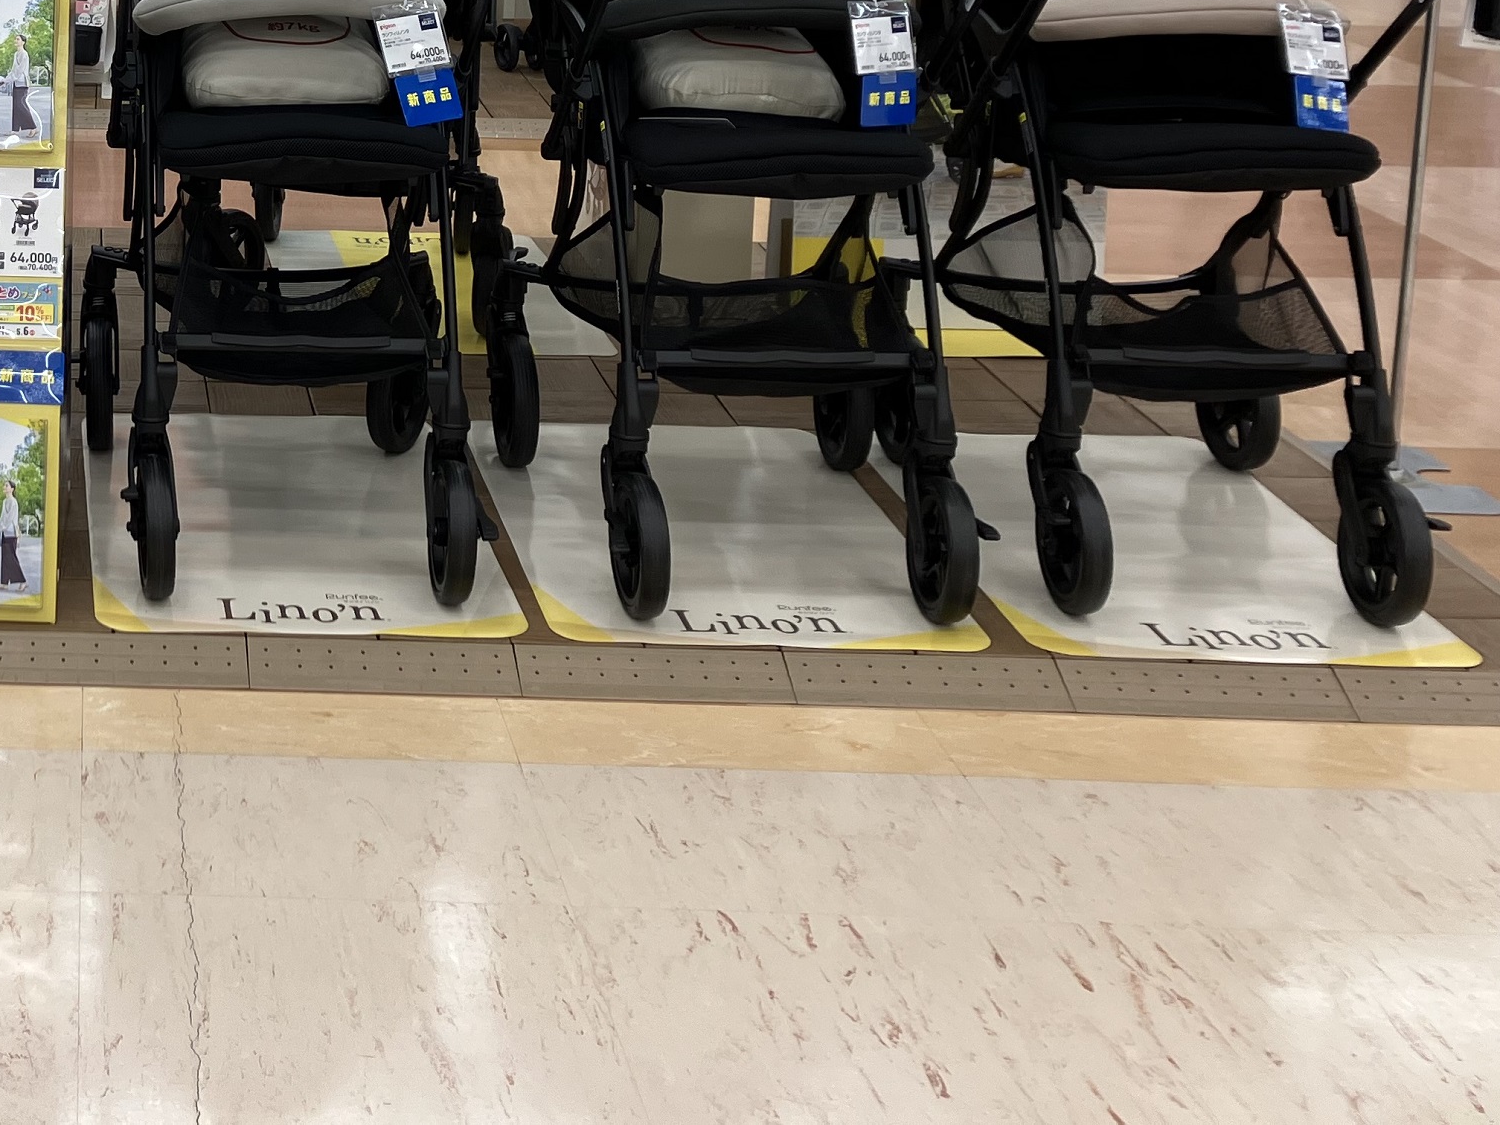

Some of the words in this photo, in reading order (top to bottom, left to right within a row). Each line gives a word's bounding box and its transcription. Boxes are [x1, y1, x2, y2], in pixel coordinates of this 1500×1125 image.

[407, 87, 452, 107] 新商品
[10, 252, 58, 263] 64,000円
[217, 598, 385, 625] Lino'n
[668, 609, 847, 635] Lino'n
[1139, 622, 1331, 650] Lino'n
